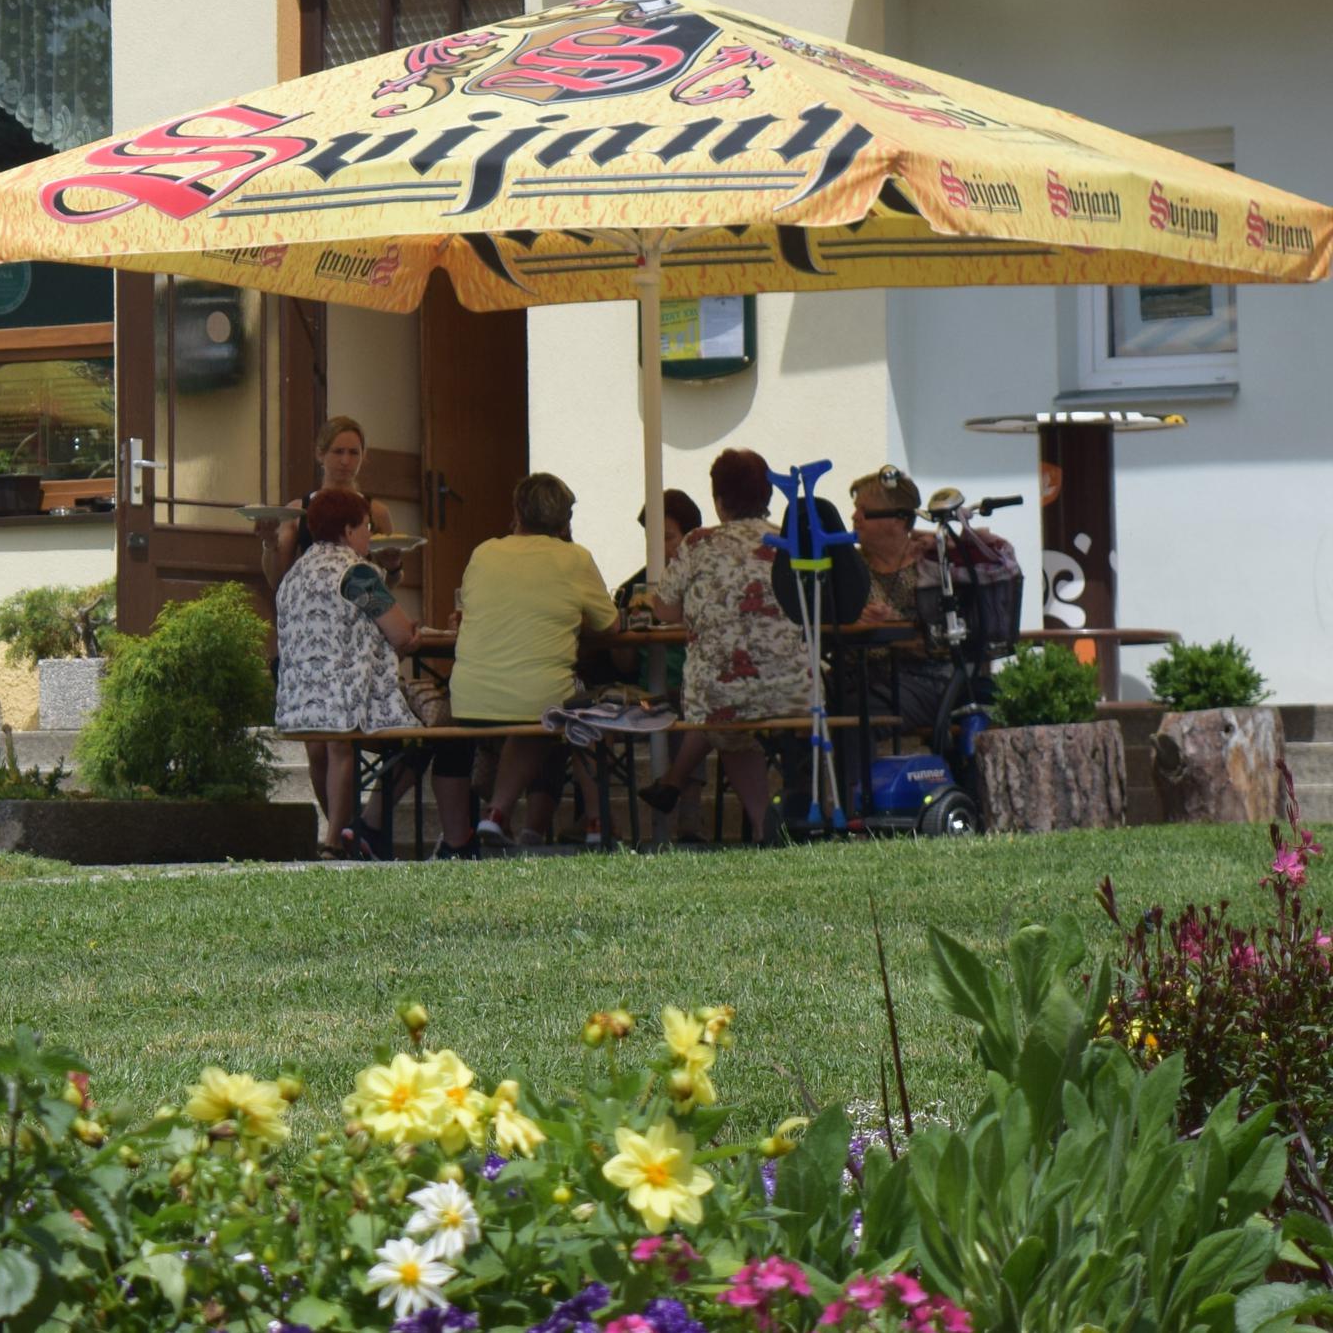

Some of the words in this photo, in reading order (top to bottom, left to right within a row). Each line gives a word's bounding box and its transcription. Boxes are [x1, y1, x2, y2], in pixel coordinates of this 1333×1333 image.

[39, 103, 874, 221] Svijany
[939, 160, 1022, 215] Svijany
[1046, 168, 1121, 223] Svijany
[1148, 180, 1219, 242] Svijany
[1246, 199, 1315, 255] Svijany
